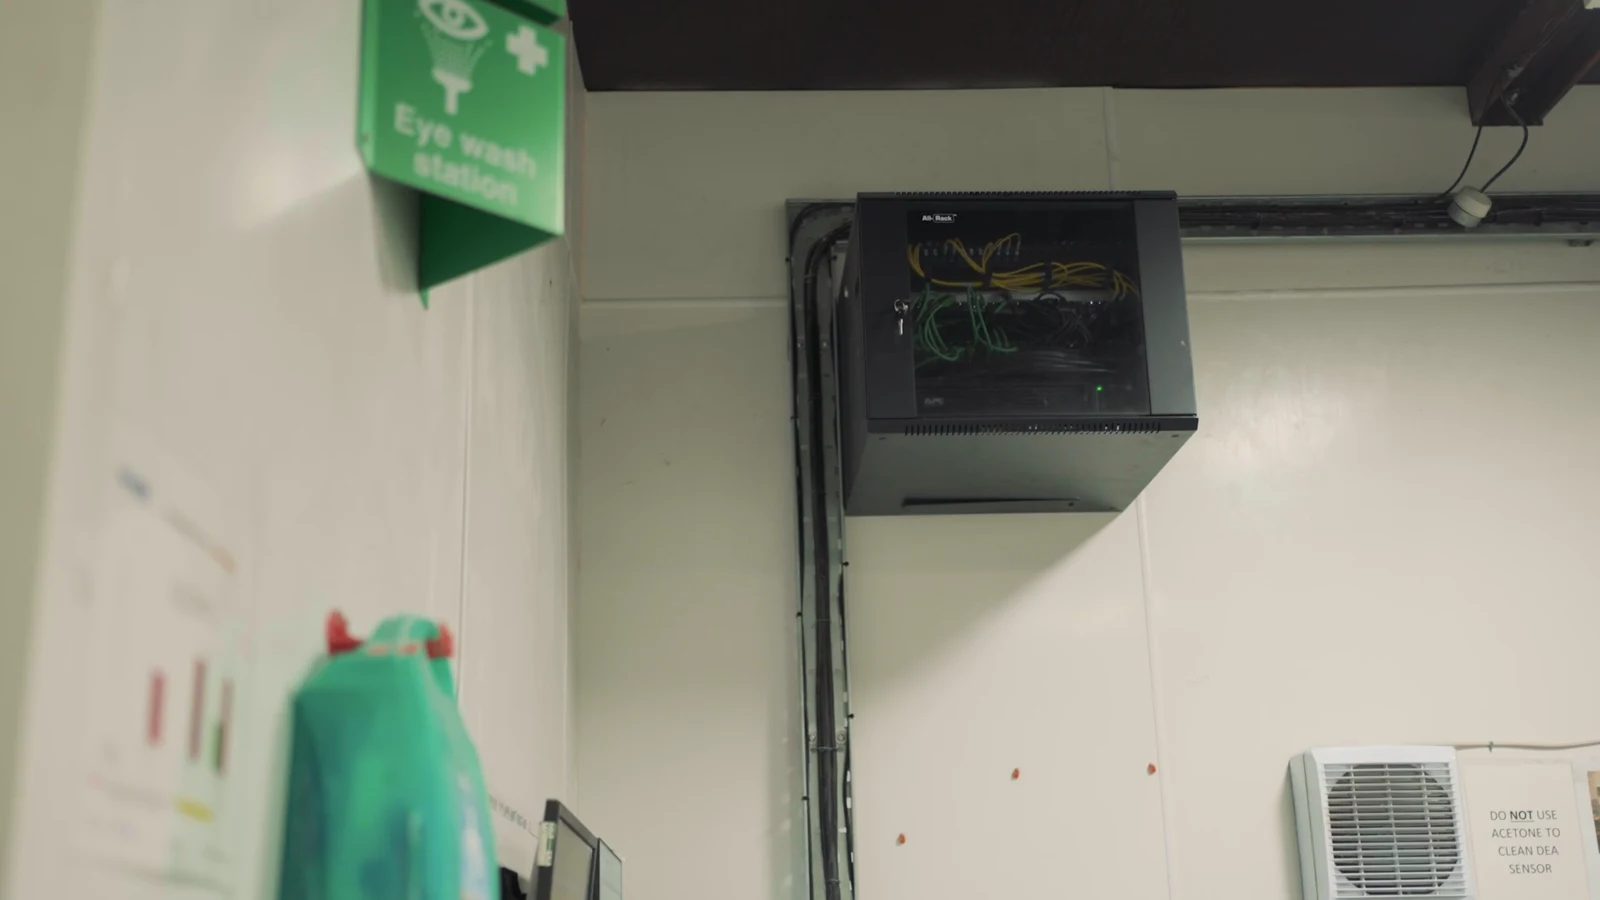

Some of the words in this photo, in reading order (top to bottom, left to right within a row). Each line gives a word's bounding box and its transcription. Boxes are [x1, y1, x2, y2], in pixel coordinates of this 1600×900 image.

[394, 102, 453, 148] Eye
[459, 133, 537, 180] wash
[412, 152, 519, 206] station
[1490, 810, 1507, 821] DO
[1509, 810, 1534, 822] NOT
[1537, 809, 1558, 820] USE
[1491, 828, 1542, 839] ACETONE
[1544, 827, 1561, 838] TO
[1498, 845, 1533, 856] CLEAN
[1536, 845, 1559, 856] DEA
[1509, 863, 1553, 875] SENSOR
